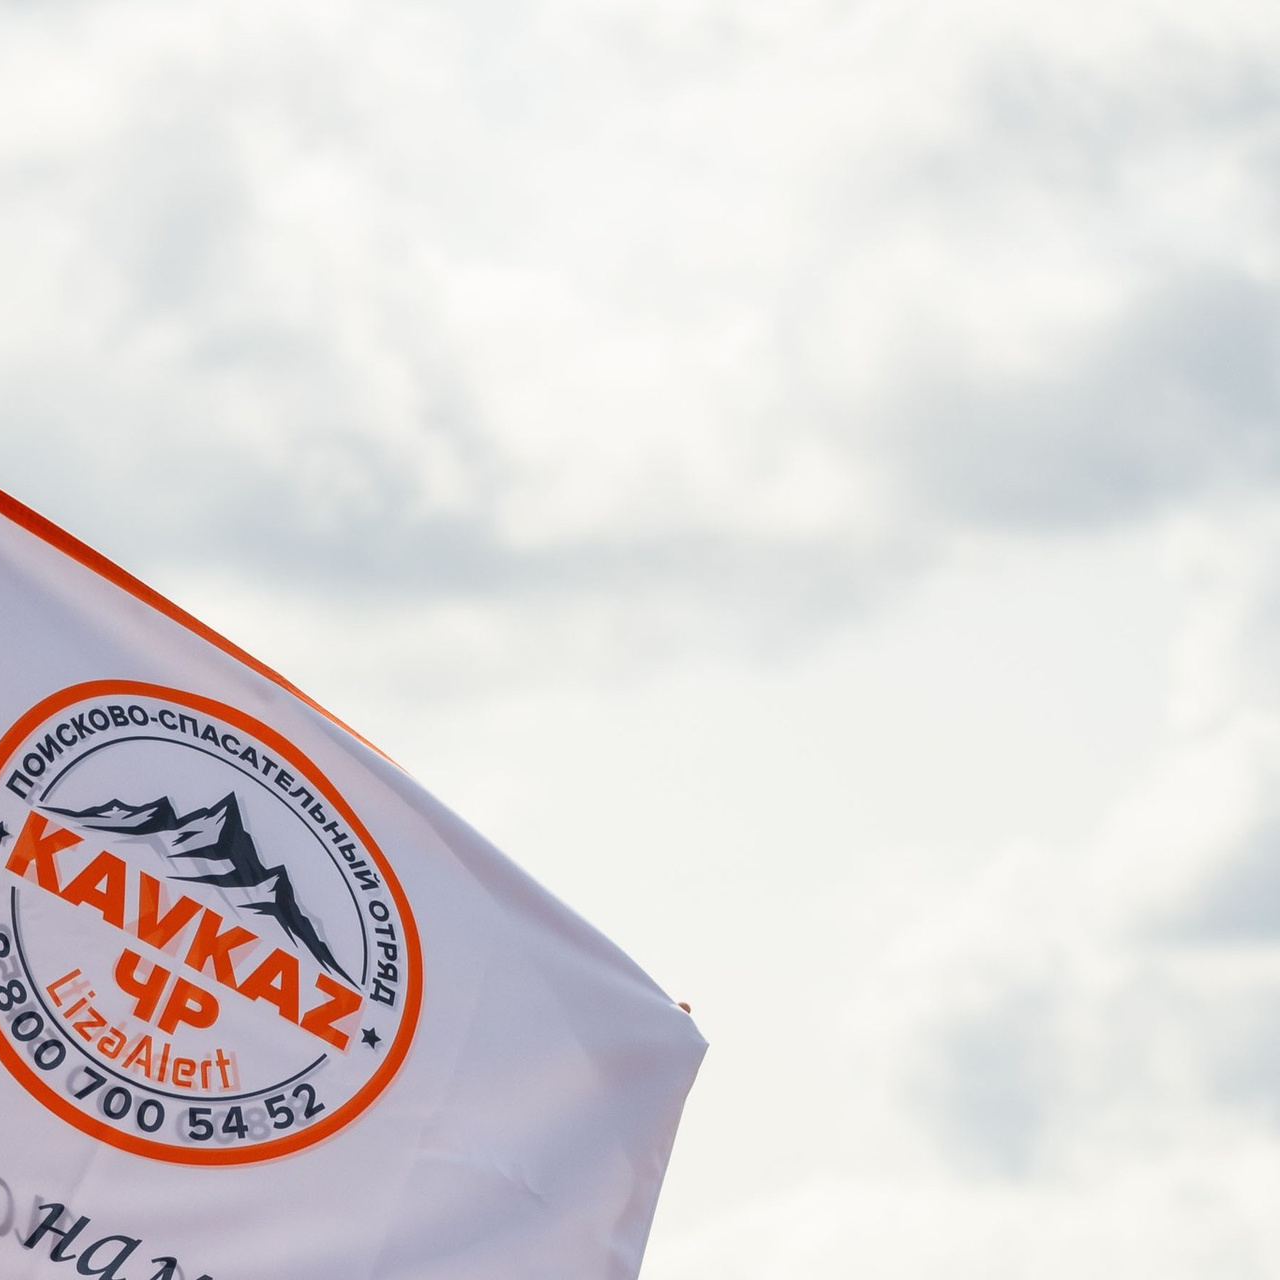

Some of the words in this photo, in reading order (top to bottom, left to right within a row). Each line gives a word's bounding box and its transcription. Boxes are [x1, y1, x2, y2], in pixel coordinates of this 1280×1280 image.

[6, 704, 381, 890] ПОИСКОВО-СПАСАТЕЛЬНЫЙ
[368, 900, 399, 1007] ОТРЯД
[5, 810, 364, 1052] KAVKAZ
[114, 948, 220, 1035] ЧР
[46, 967, 231, 1089] LizaAlert
[73, 1067, 166, 1133] 700
[187, 1106, 249, 1141] 54
[265, 1083, 325, 1130] 52
